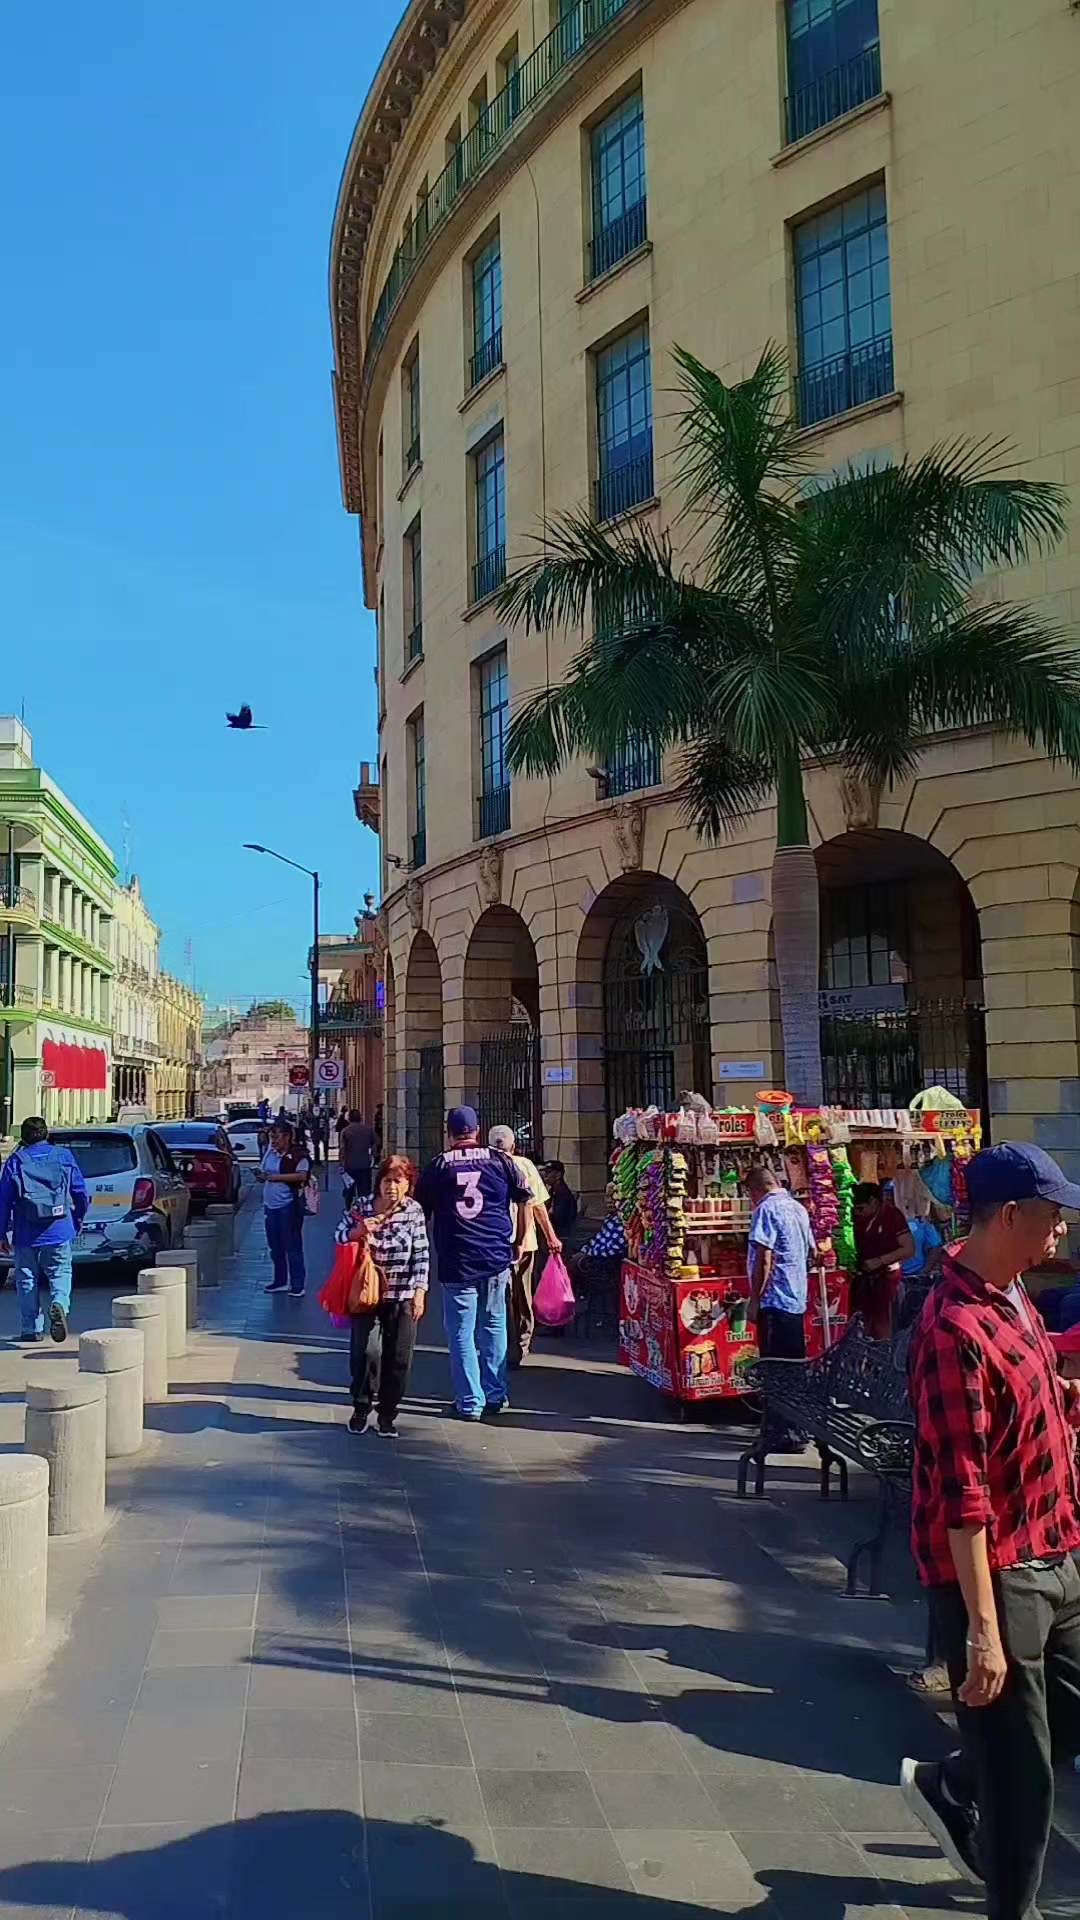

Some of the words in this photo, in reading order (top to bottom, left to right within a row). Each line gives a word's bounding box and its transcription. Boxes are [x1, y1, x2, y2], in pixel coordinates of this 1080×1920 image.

[829, 995, 852, 1005] SAT
[443, 1147, 491, 1163] WILSON
[455, 1171, 484, 1219] 3
